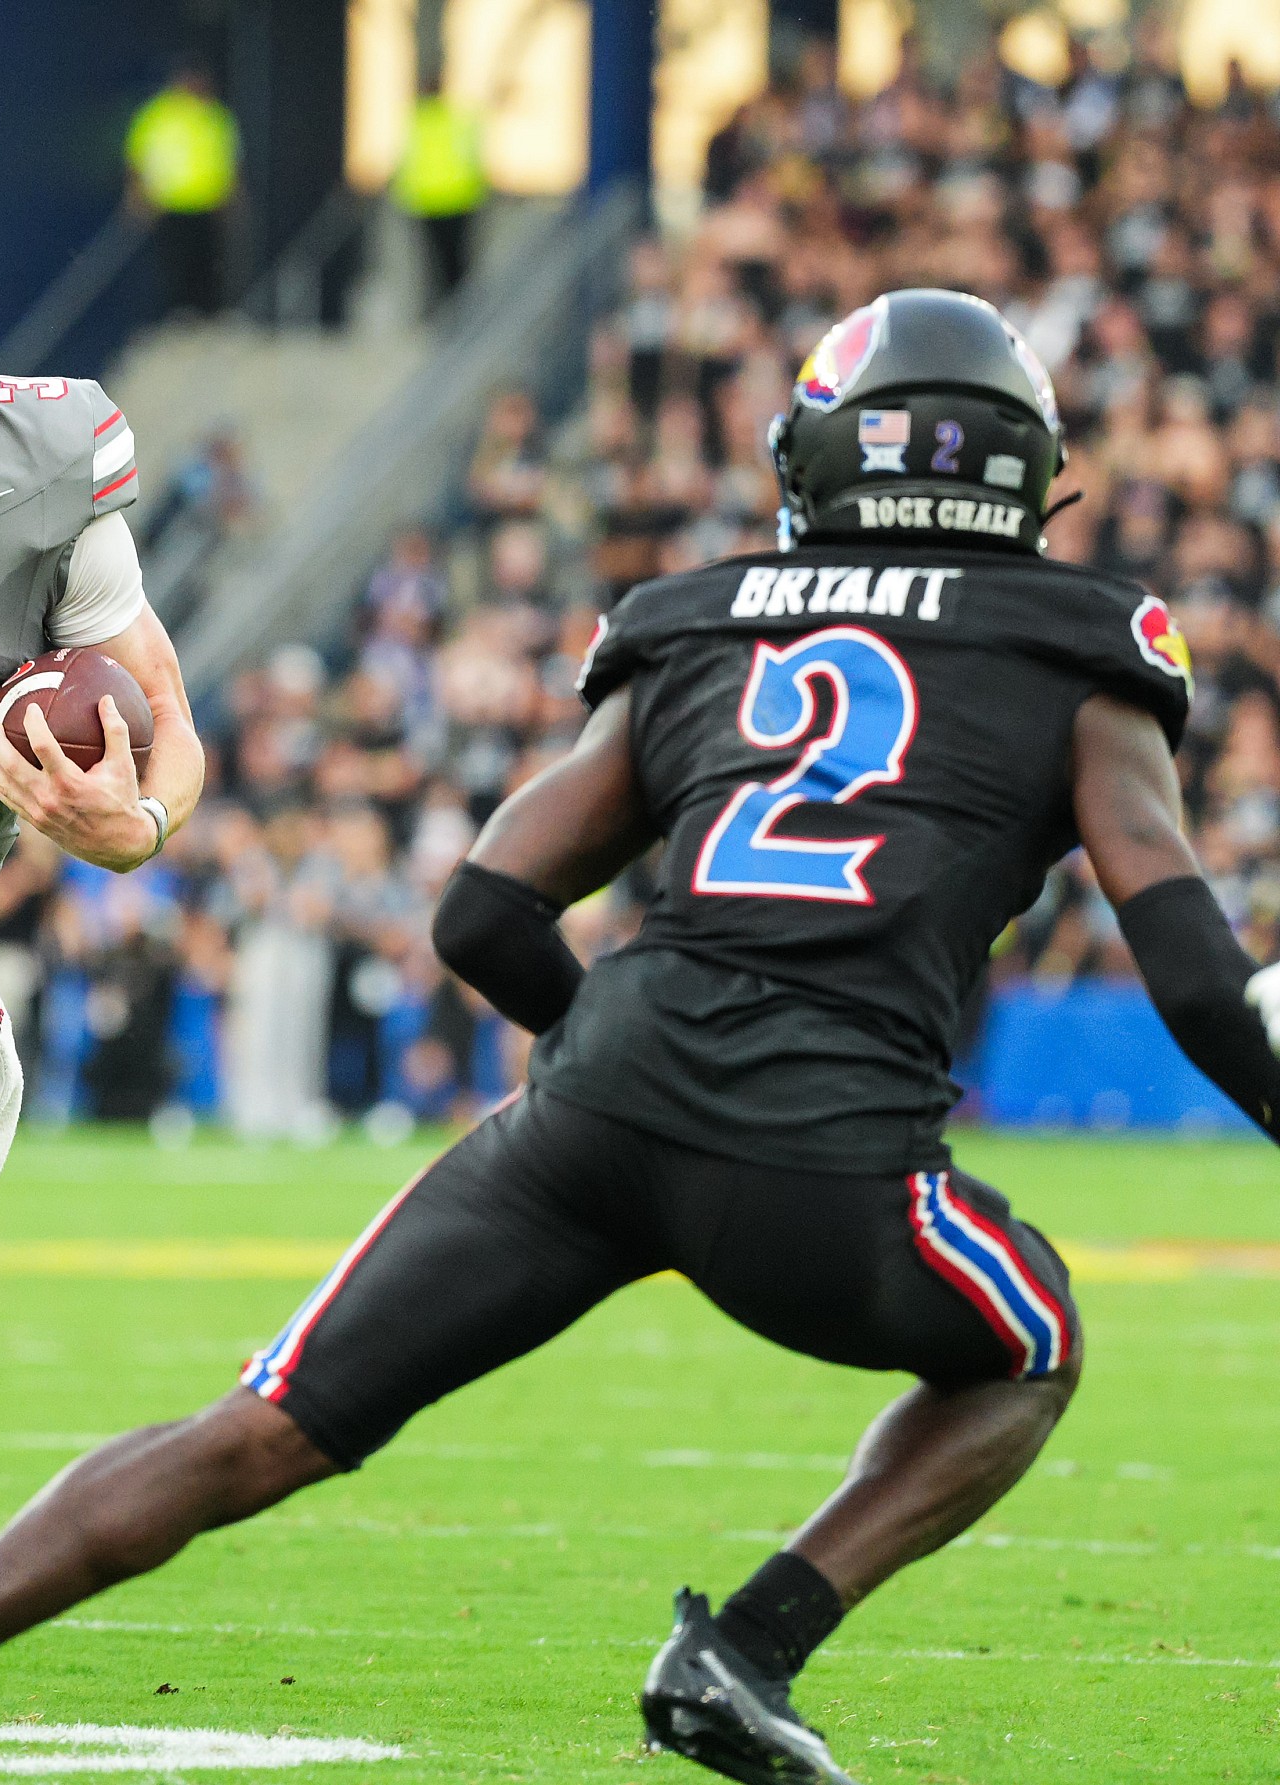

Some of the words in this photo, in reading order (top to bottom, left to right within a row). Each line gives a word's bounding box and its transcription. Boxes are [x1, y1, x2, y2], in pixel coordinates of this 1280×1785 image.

[931, 419, 965, 474] 2
[857, 497, 934, 529] ROCK
[937, 498, 1025, 538] CHALK
[730, 565, 963, 622] BRYANT
[691, 624, 918, 905] 2
